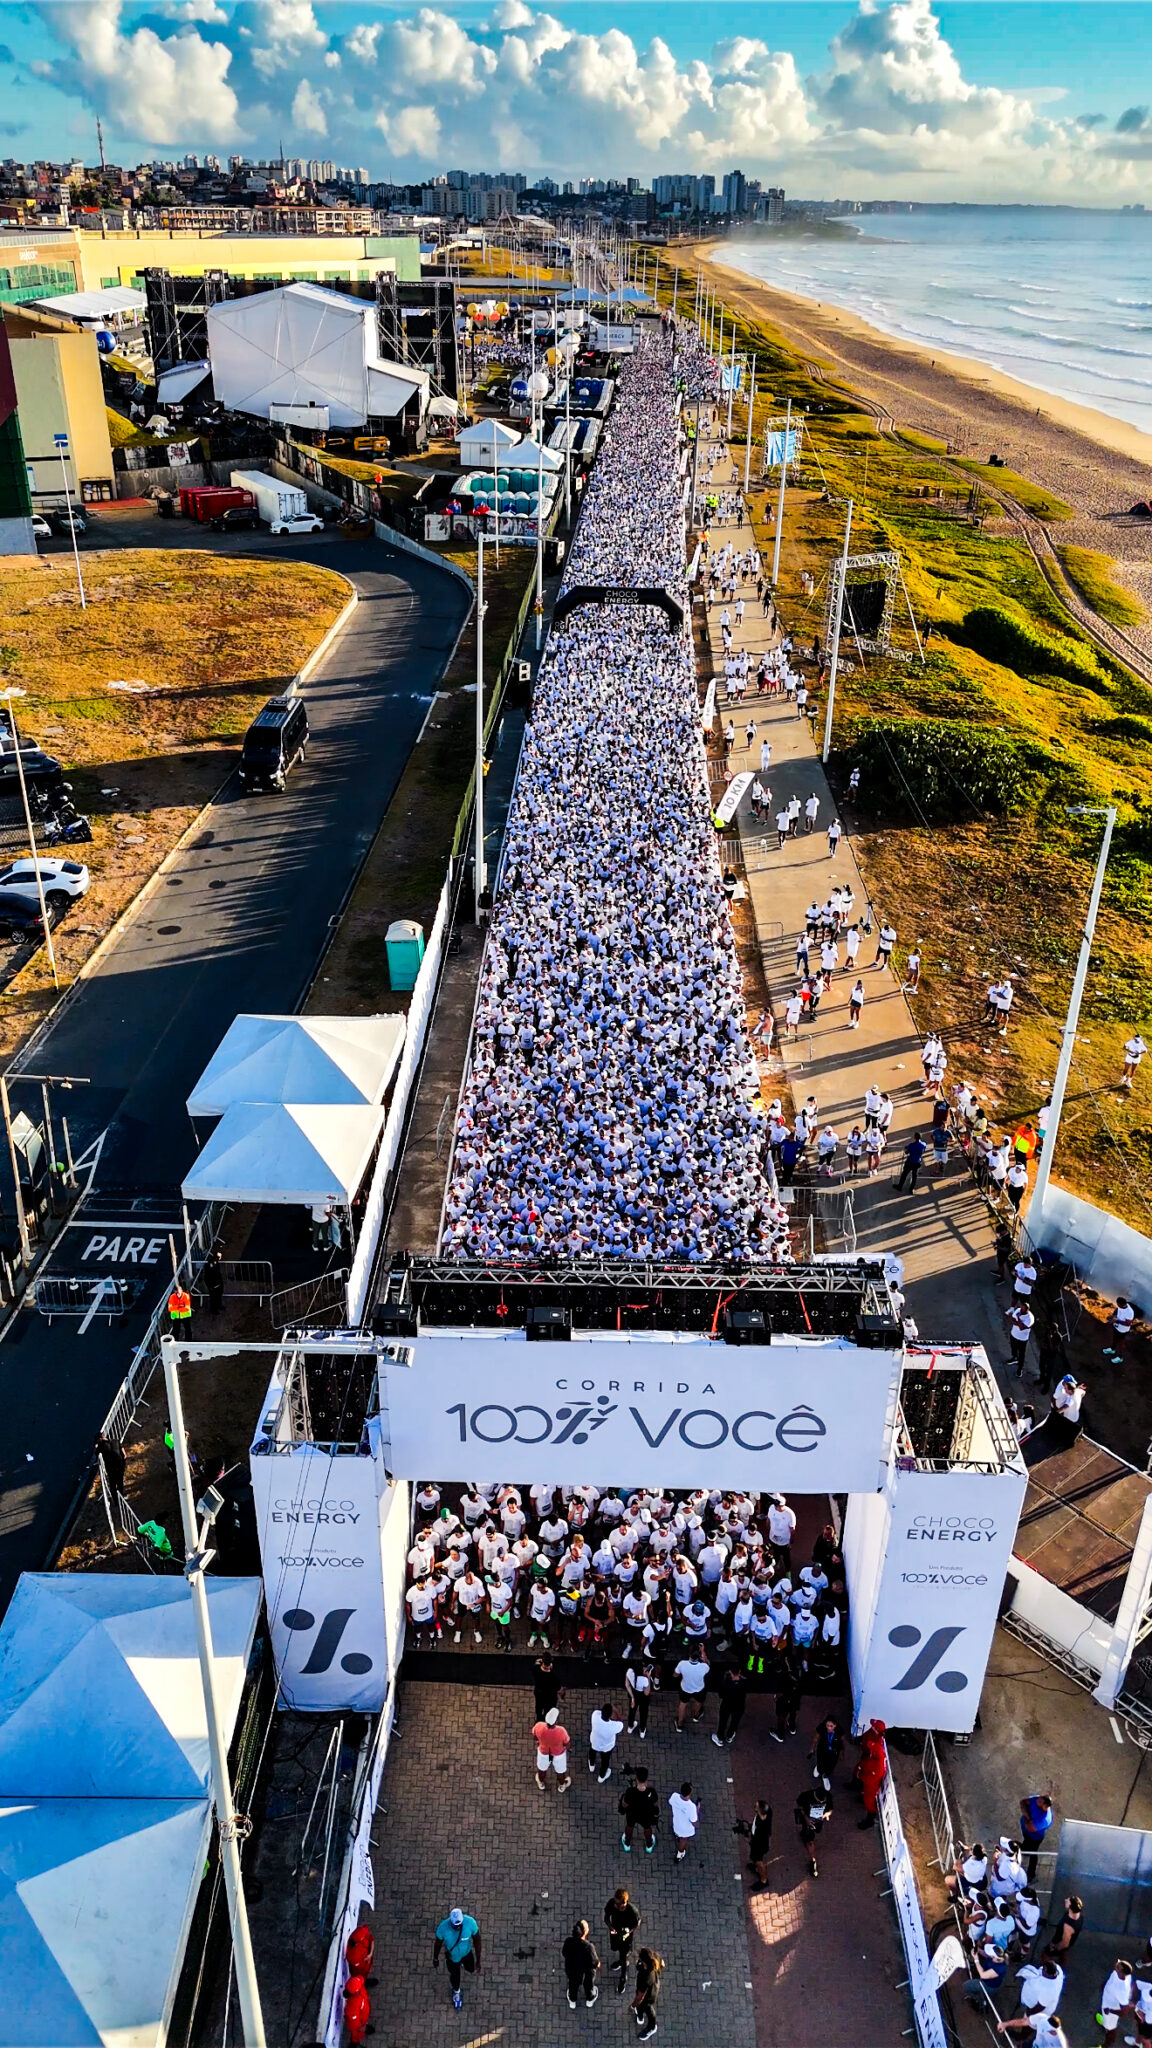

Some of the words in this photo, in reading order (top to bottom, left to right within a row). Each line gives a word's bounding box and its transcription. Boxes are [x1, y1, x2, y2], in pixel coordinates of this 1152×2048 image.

[605, 589, 638, 598] CHOCO
[729, 777, 747, 796] KM
[80, 1235, 167, 1264] PARE
[555, 1378, 717, 1395] CORRIDA
[274, 1499, 355, 1512] CHOCO
[271, 1511, 361, 1525] ENERGY
[913, 1515, 994, 1530] CHOCO
[906, 1528, 998, 1542] ENERGY
